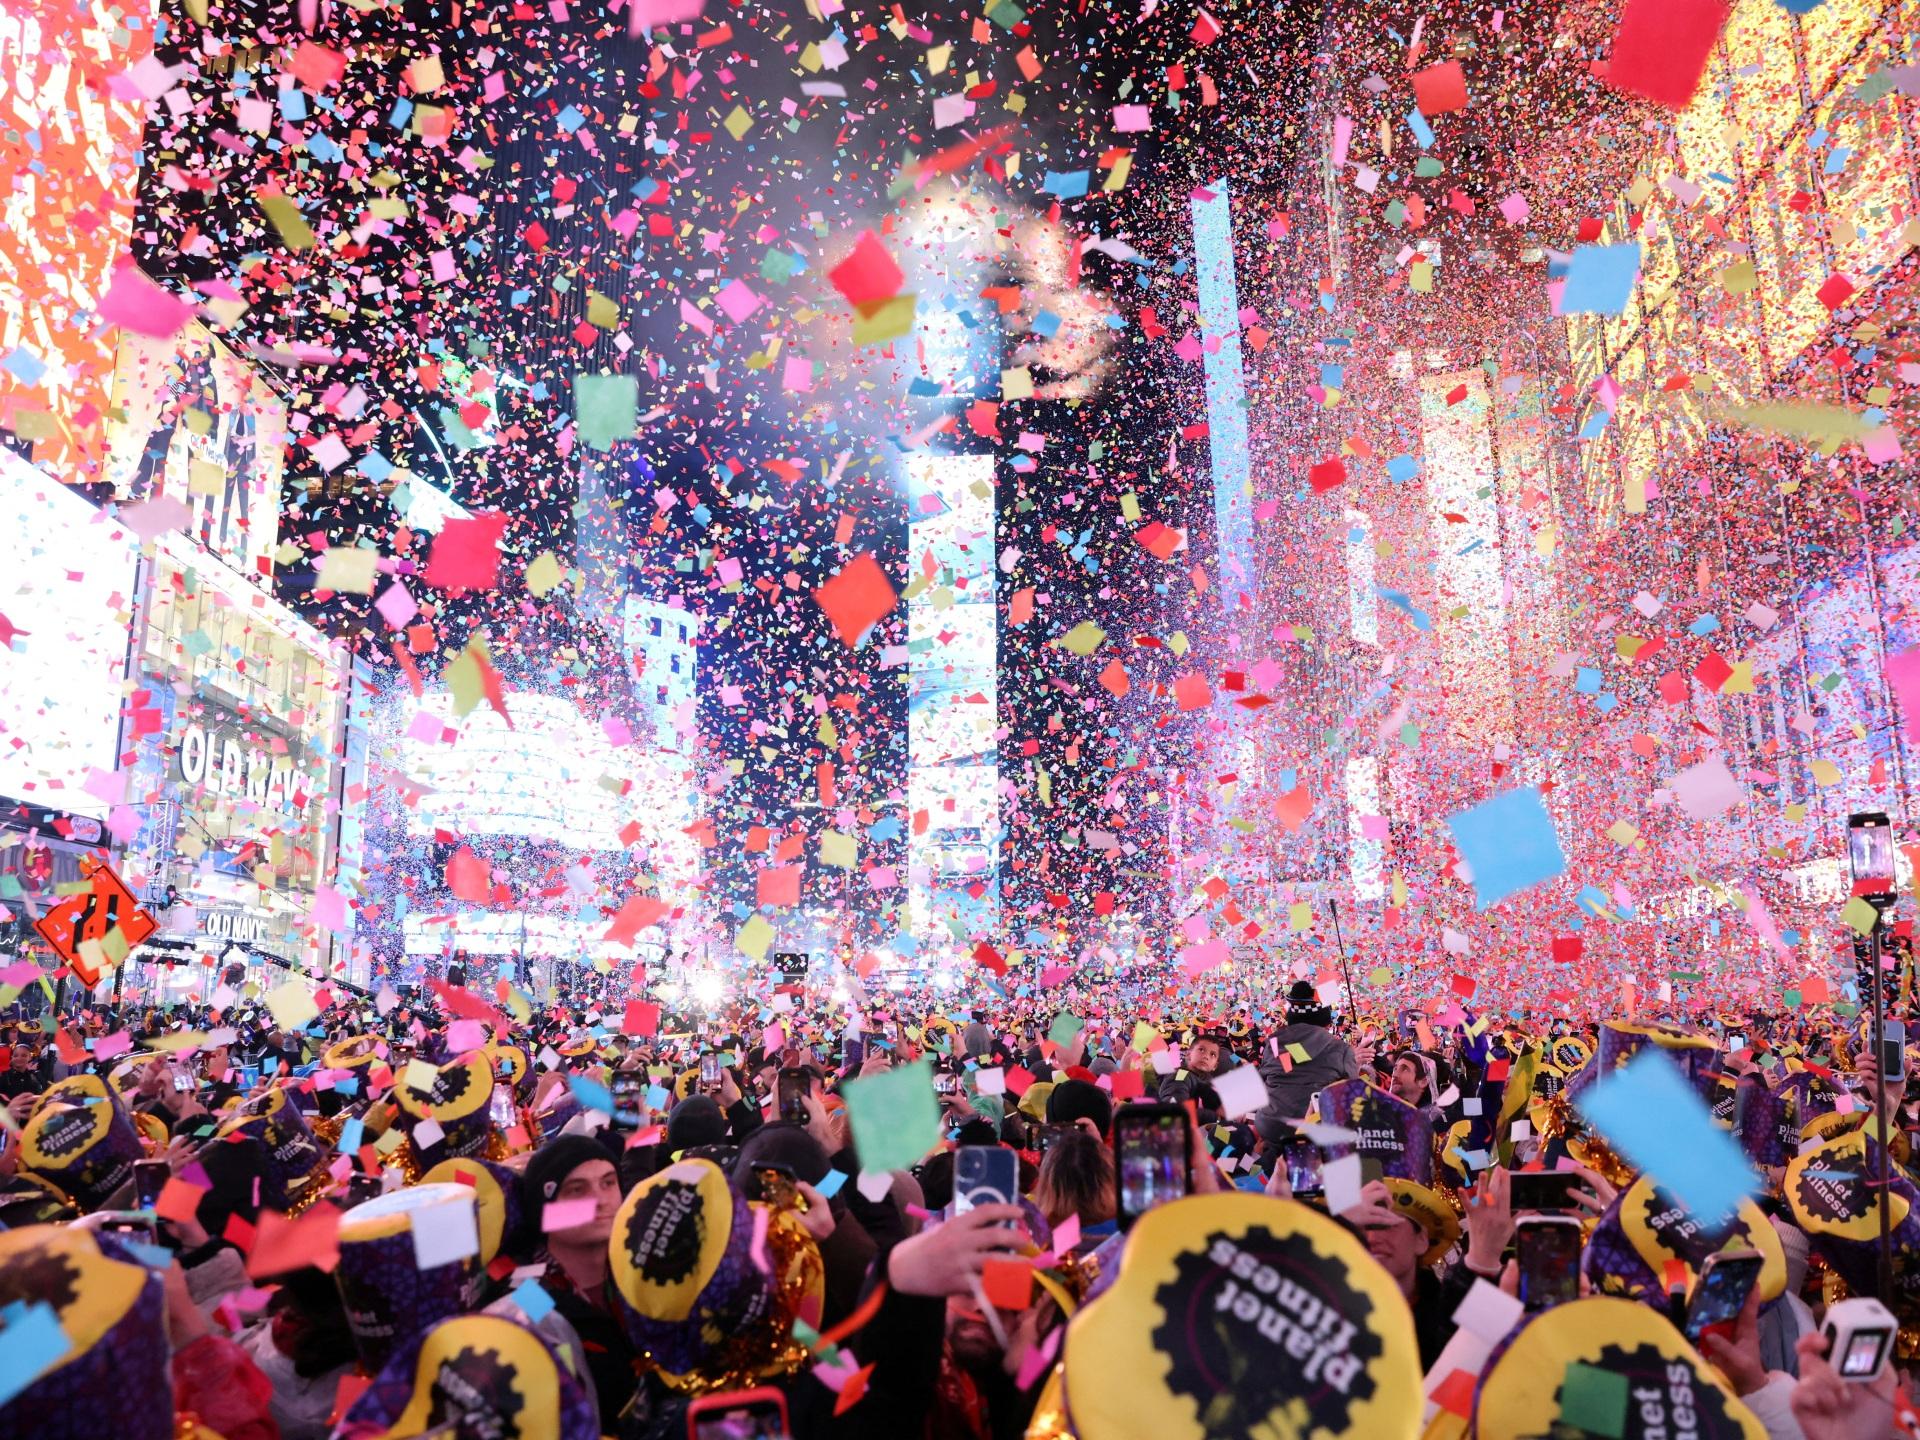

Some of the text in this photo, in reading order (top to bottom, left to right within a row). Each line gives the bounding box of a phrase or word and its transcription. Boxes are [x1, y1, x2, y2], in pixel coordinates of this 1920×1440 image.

[179, 724, 242, 796] OLD
[205, 912, 262, 941] OLD NAVY
[41, 1119, 83, 1150] planet
[49, 1122, 94, 1151] fitness
[273, 1132, 303, 1161] planet
[1355, 1139, 1405, 1152] fitness
[635, 1191, 680, 1266] fitness
[653, 1188, 695, 1258] planet
[1208, 1239, 1358, 1355] fitness
[1214, 1279, 1364, 1395] planet
